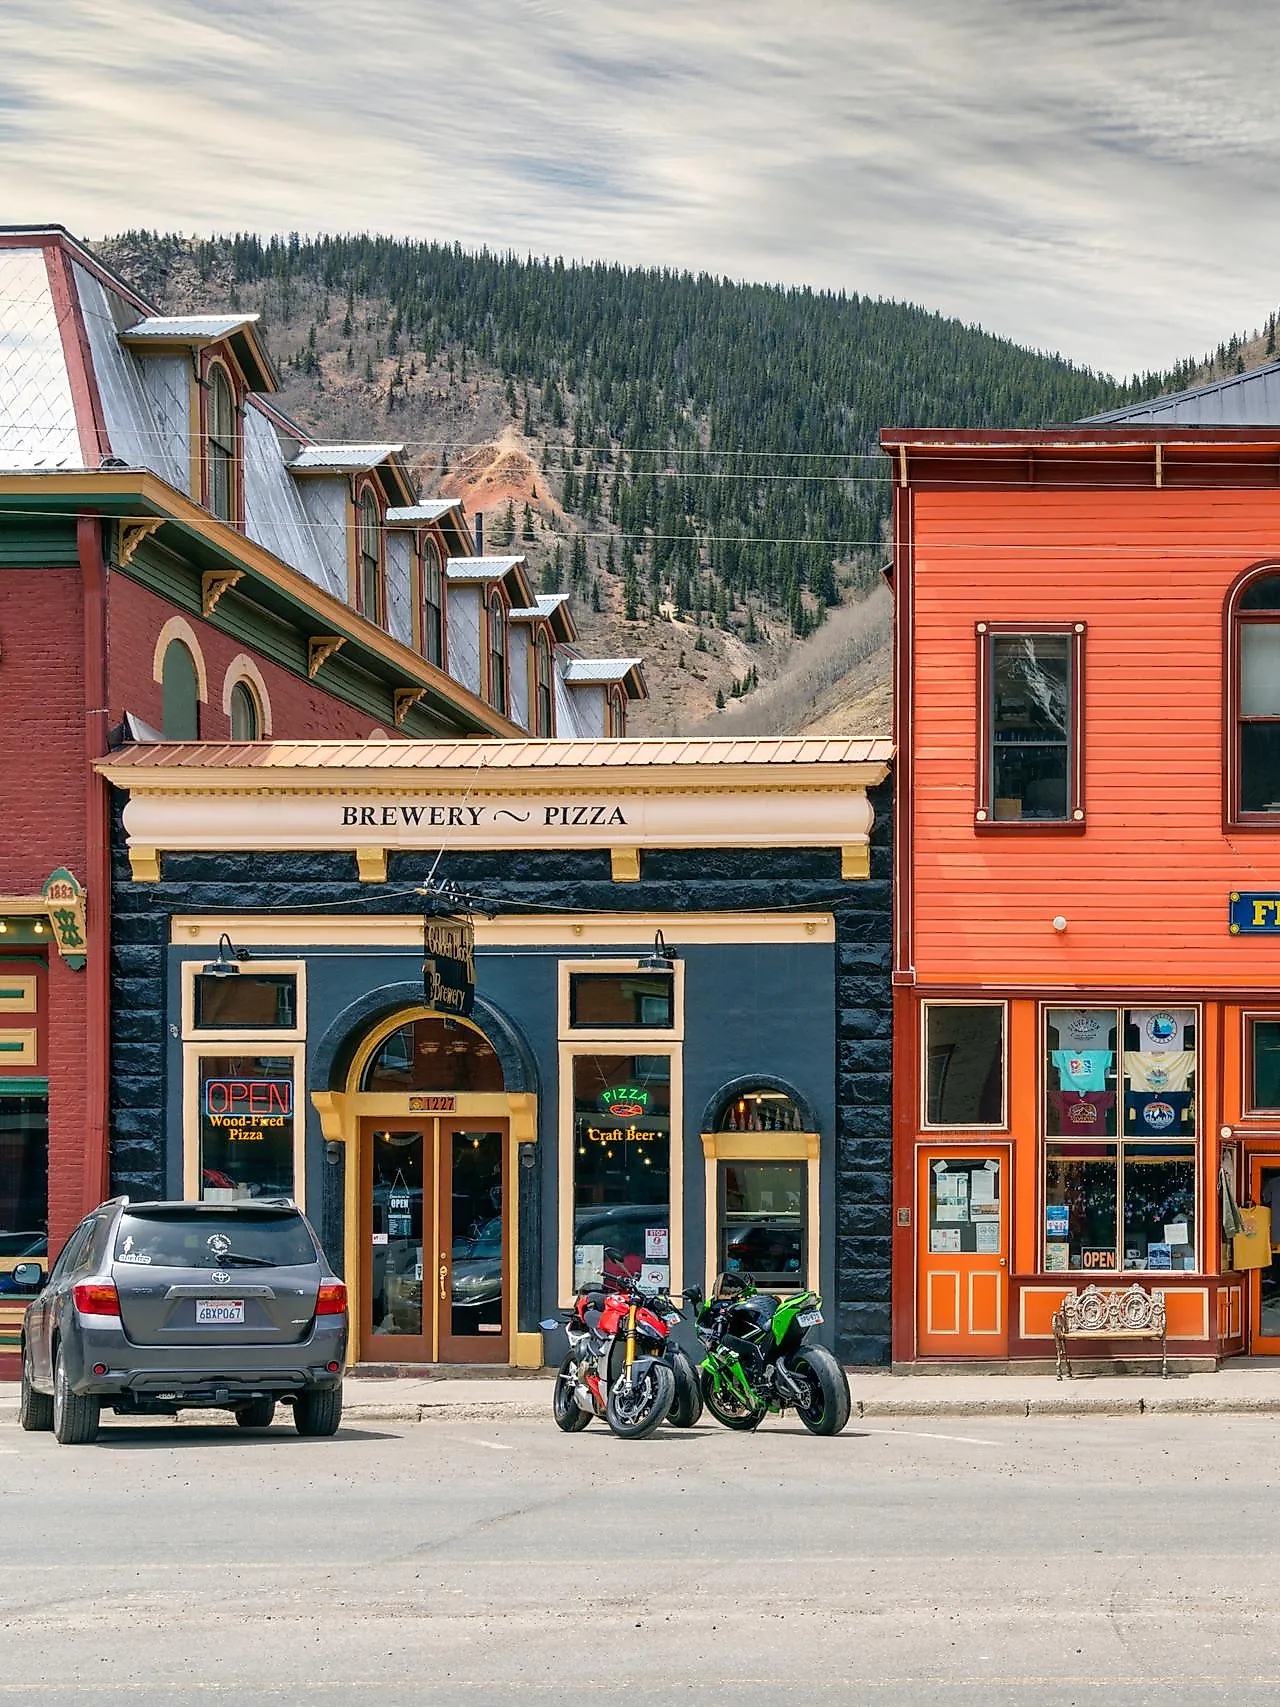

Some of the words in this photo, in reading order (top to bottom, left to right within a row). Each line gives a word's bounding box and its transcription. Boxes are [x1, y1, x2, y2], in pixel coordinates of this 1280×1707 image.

[340, 806, 487, 826] BREWERY
[543, 806, 629, 826] PIZZA
[433, 972, 466, 1012] Brewery
[208, 1083, 289, 1113] OPEN
[426, 1096, 455, 1110] 1227
[602, 1088, 649, 1105] PIZZA
[209, 1115, 285, 1127] Wood-Fired
[228, 1129, 264, 1140] Pizza
[589, 1129, 624, 1141] Craft
[625, 1129, 656, 1141] Beer
[390, 1199, 409, 1209] OPEN
[1084, 1251, 1115, 1269] OPEN
[199, 1308, 241, 1320] 6BXP067
